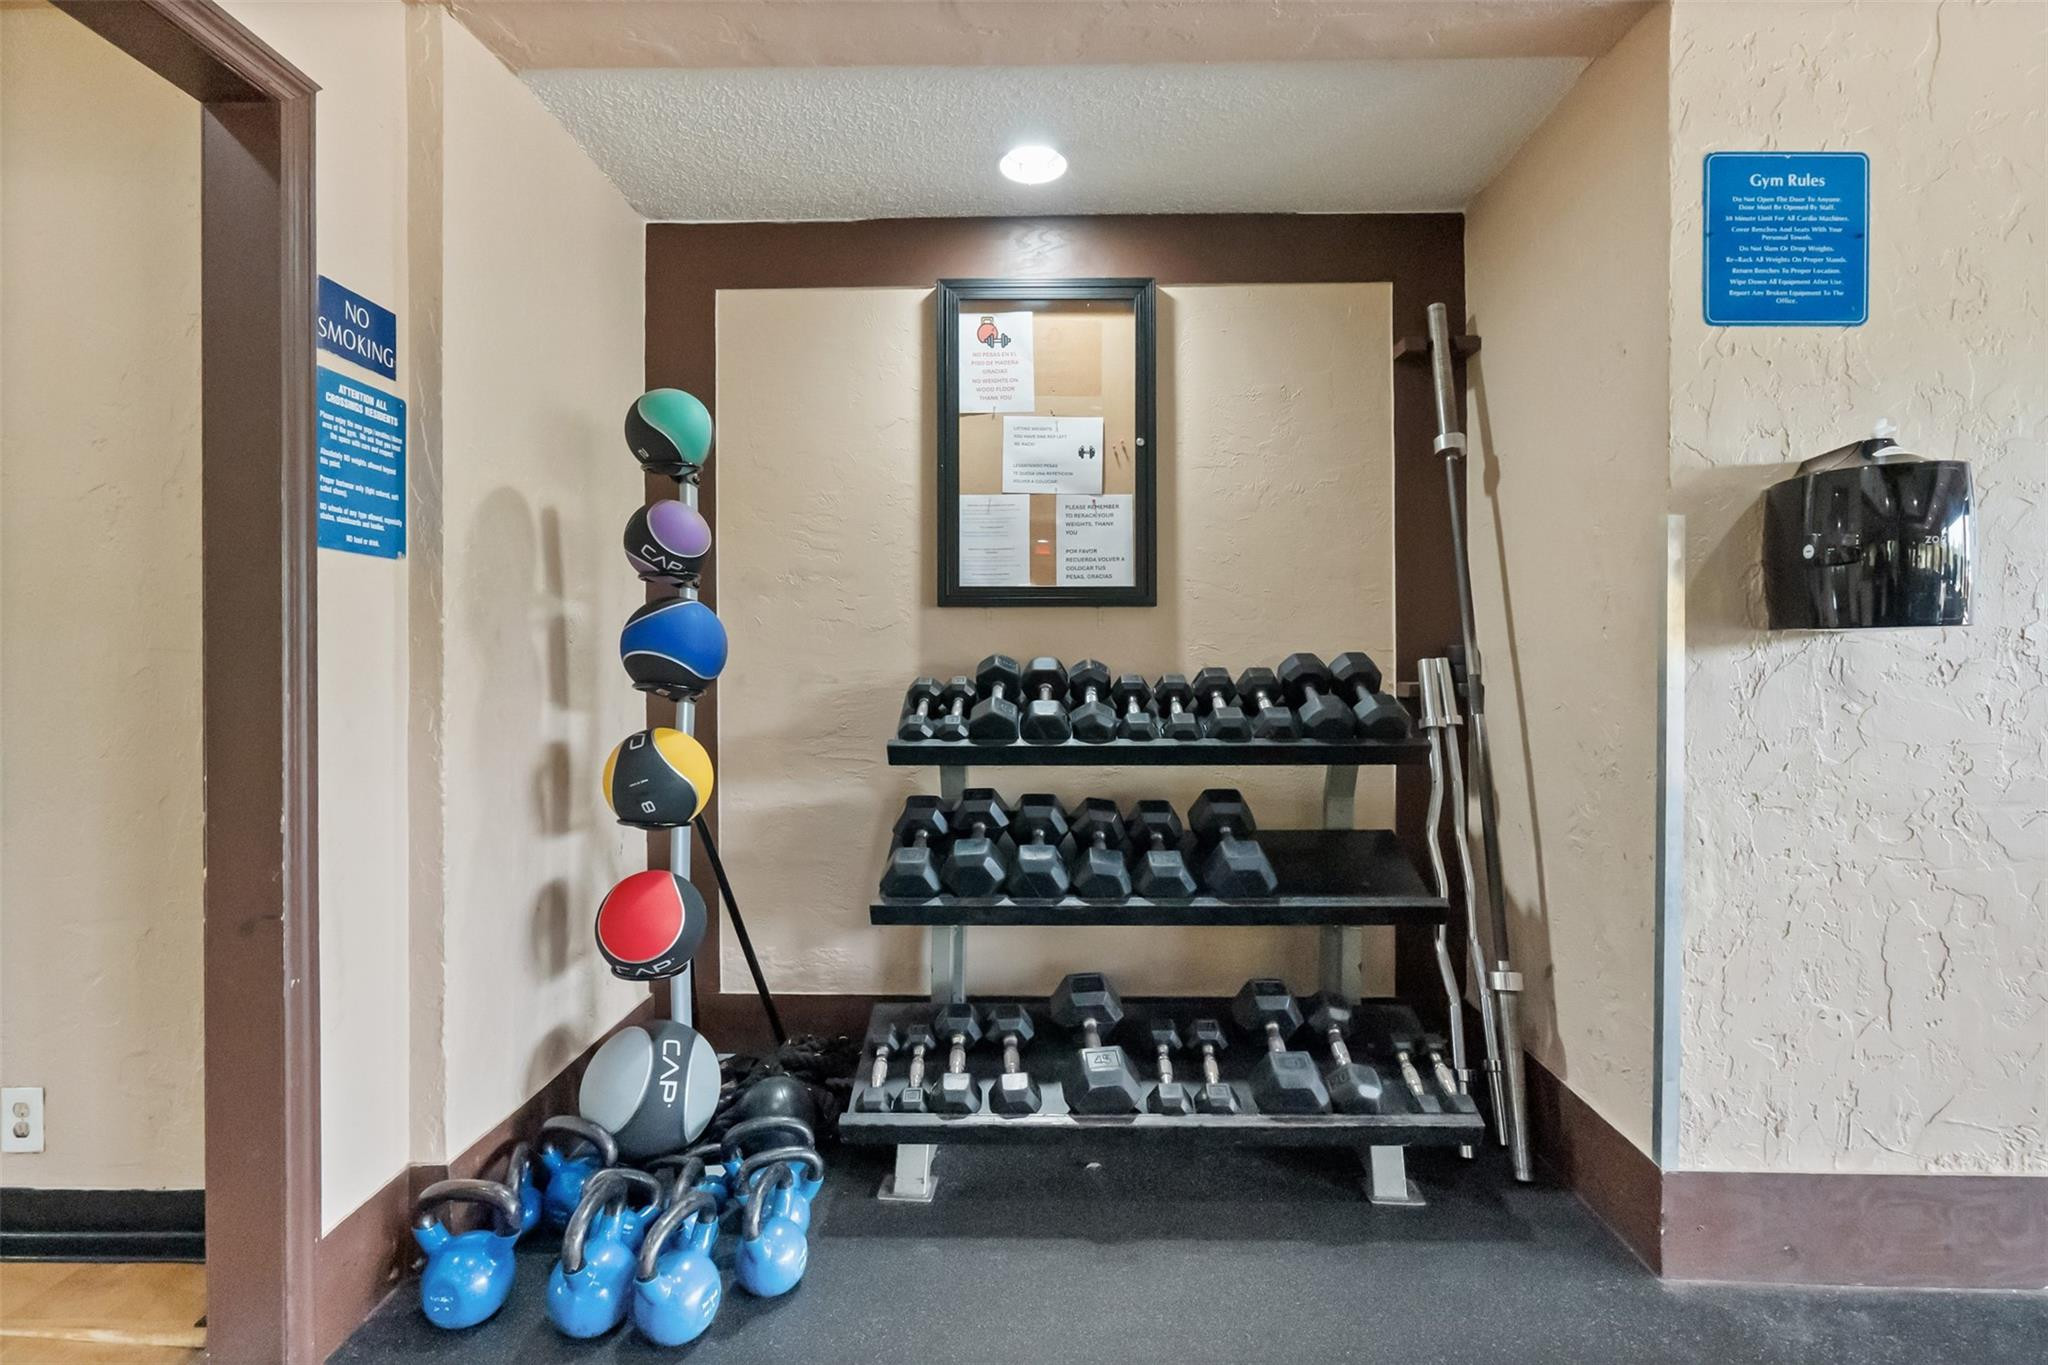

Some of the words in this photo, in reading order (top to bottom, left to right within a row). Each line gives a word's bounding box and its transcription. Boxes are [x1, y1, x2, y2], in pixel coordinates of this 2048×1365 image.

[1750, 173, 1783, 189] Gym
[1788, 173, 1825, 187] Rules
[1733, 196, 1742, 204] Do
[1744, 196, 1755, 204] Not
[1757, 196, 1774, 204] Open
[1776, 196, 1788, 204] The
[1789, 196, 1805, 204] Door
[1808, 196, 1815, 204] To
[345, 300, 369, 329] NO
[318, 316, 394, 368] SMOKING
[338, 384, 375, 406] ATTENTION
[376, 399, 388, 411] ALL
[640, 544, 684, 570] CAP
[641, 800, 656, 813] 8
[615, 959, 672, 976] CAP
[659, 1039, 682, 1104] CAP
